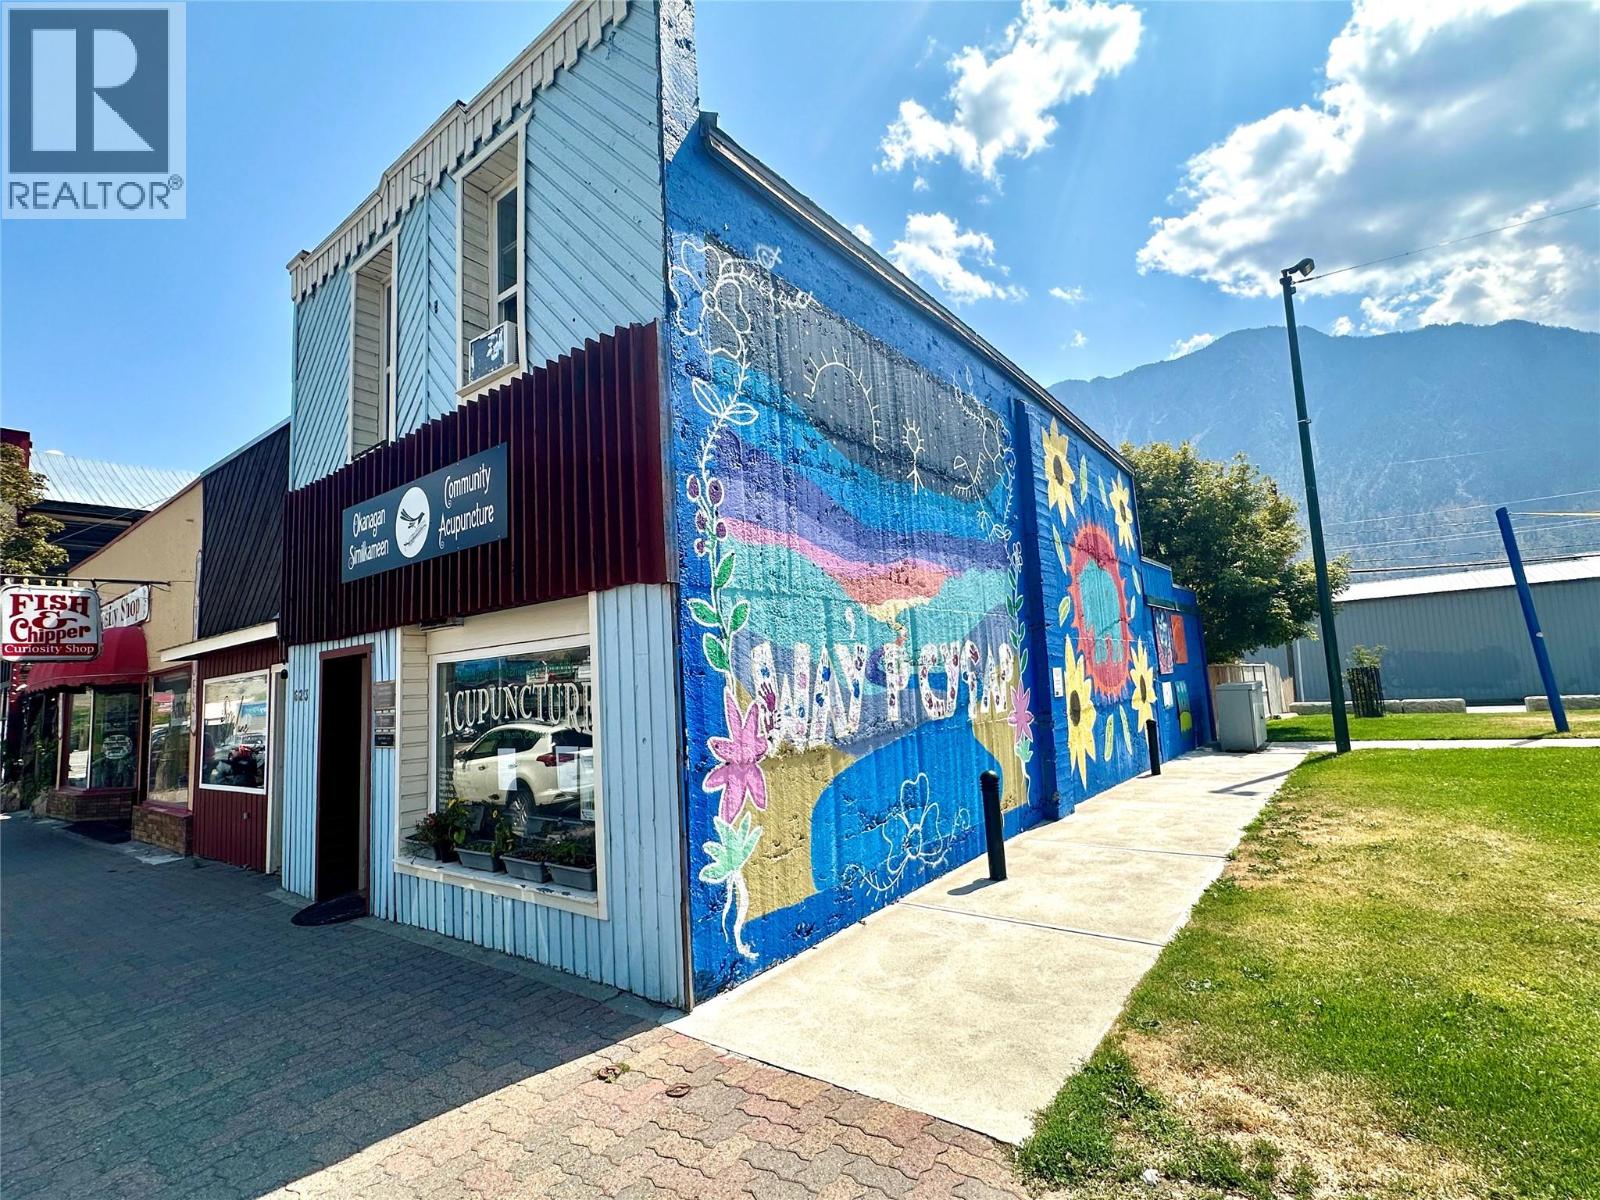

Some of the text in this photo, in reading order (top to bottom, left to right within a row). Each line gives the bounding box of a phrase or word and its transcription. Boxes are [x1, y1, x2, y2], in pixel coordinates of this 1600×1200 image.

[444, 463, 491, 508] Community
[352, 508, 386, 538] Okanagan
[438, 502, 494, 550] Acupuncture
[347, 539, 389, 570] Similkameen
[9, 593, 91, 618] FISH
[32, 610, 78, 629] &
[9, 617, 91, 645] Chipper
[4, 643, 95, 655] Curiosity Shop
